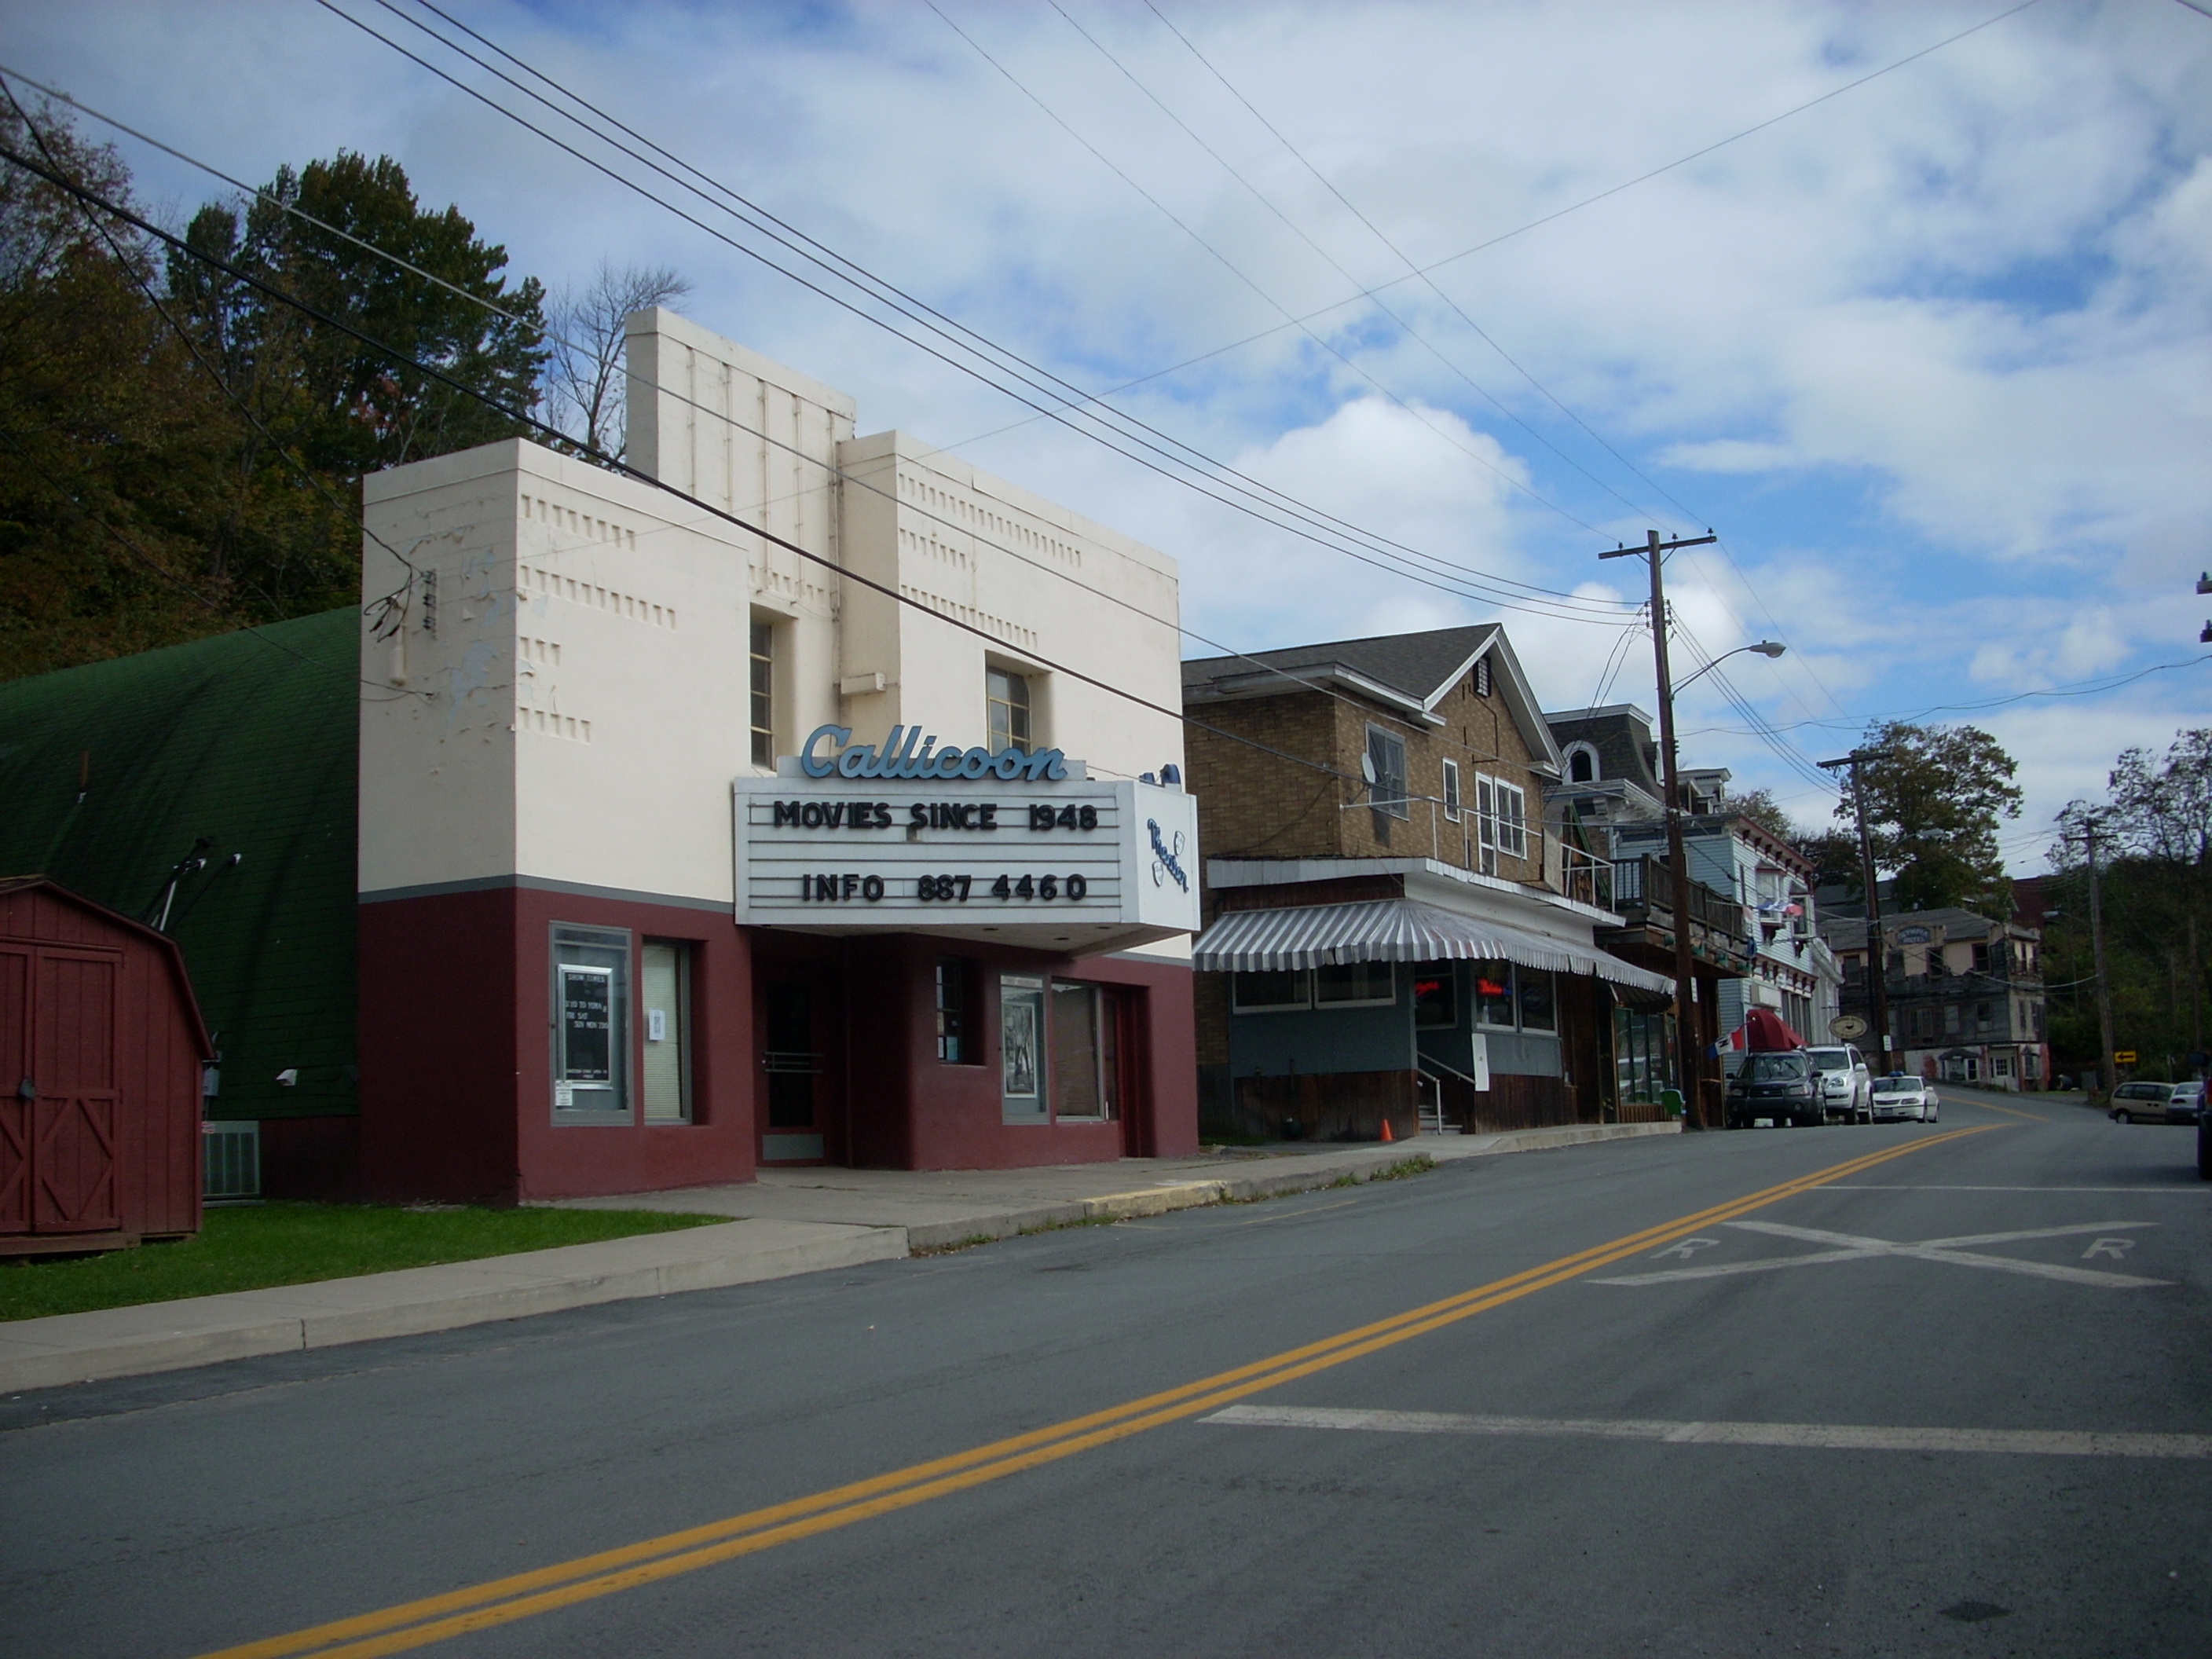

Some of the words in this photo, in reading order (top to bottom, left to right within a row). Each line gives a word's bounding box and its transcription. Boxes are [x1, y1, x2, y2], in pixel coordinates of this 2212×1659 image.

[801, 724, 1068, 781] Callicoon
[774, 801, 892, 829] MOVIES
[910, 803, 998, 830] SINCE
[1029, 804, 1098, 831] 1948
[803, 874, 884, 901] INFO
[917, 874, 972, 902] 887
[991, 873, 1087, 901] 4460
[1650, 1238, 1720, 1258] R
[2080, 1237, 2136, 1258] R
